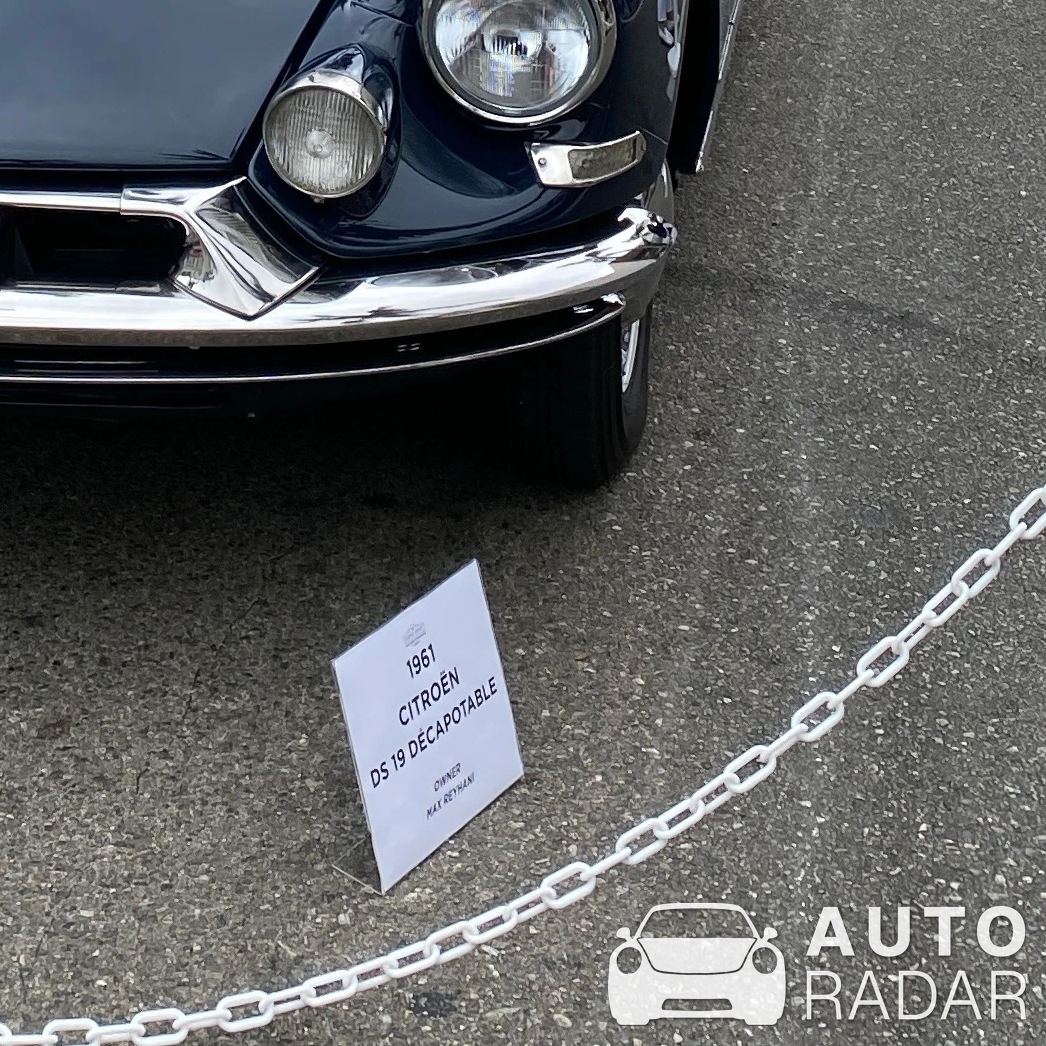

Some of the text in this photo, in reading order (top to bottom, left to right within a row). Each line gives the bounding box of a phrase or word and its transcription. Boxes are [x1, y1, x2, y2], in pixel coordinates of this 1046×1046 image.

[406, 643, 437, 679] 1961
[398, 667, 461, 727] CITROËN
[370, 675, 499, 790] DS 19 DÉCAPOTABLE
[426, 771, 476, 821] MAX REYHANI
[433, 762, 462, 793] OWNER
